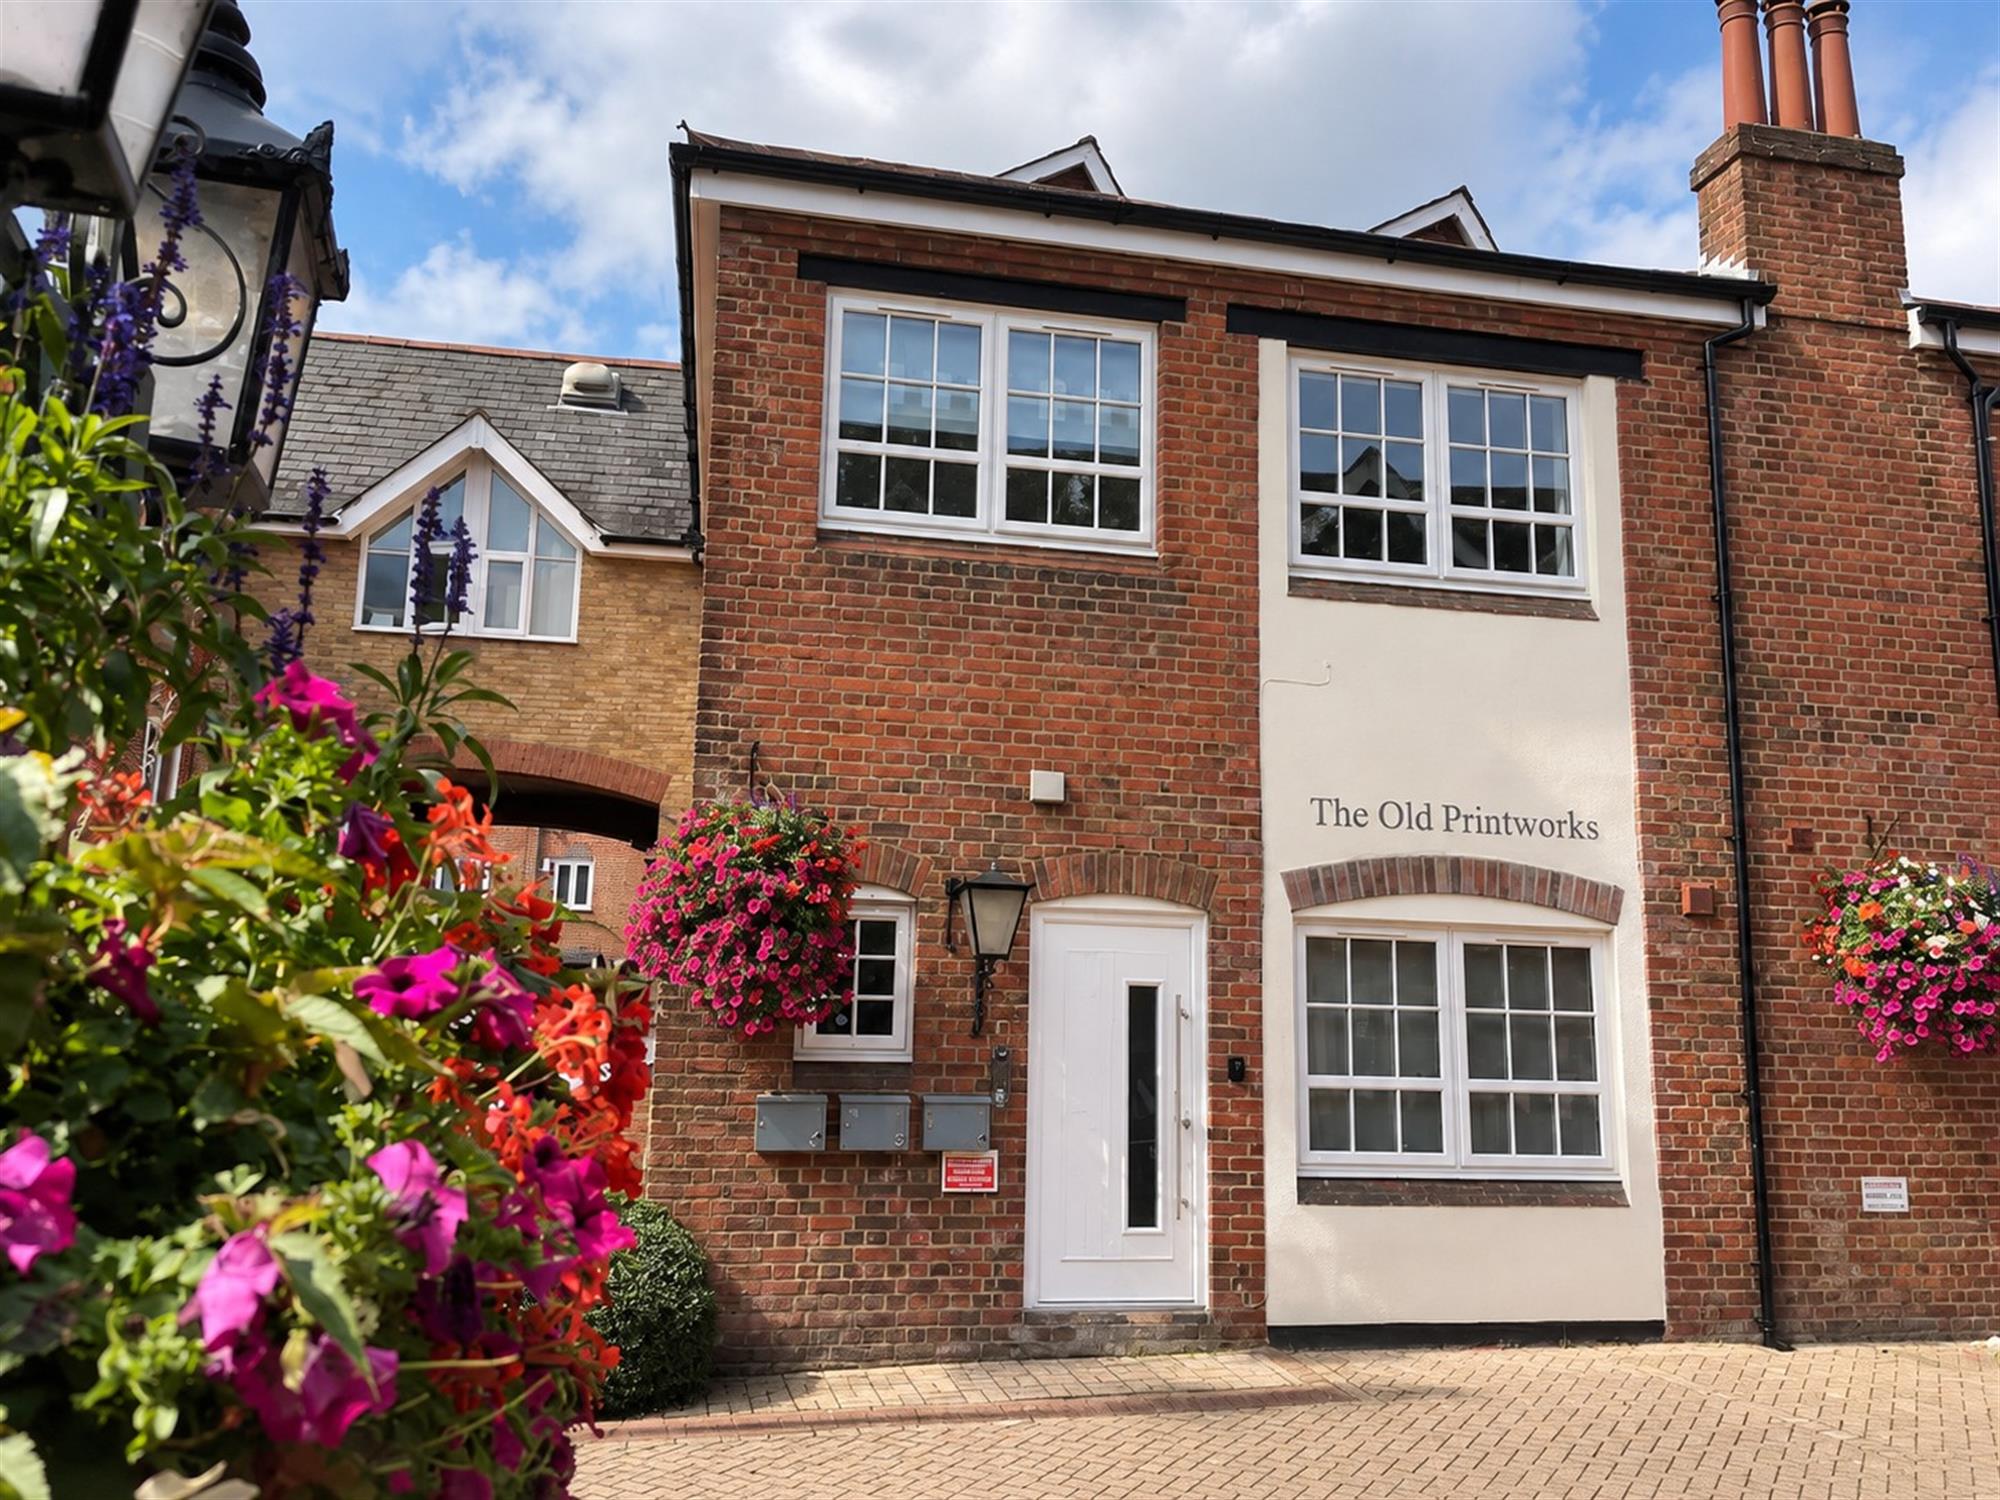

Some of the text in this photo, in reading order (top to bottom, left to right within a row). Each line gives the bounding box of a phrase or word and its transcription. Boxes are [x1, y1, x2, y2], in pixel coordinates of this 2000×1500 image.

[1310, 797, 1600, 841] The Old Printworks
